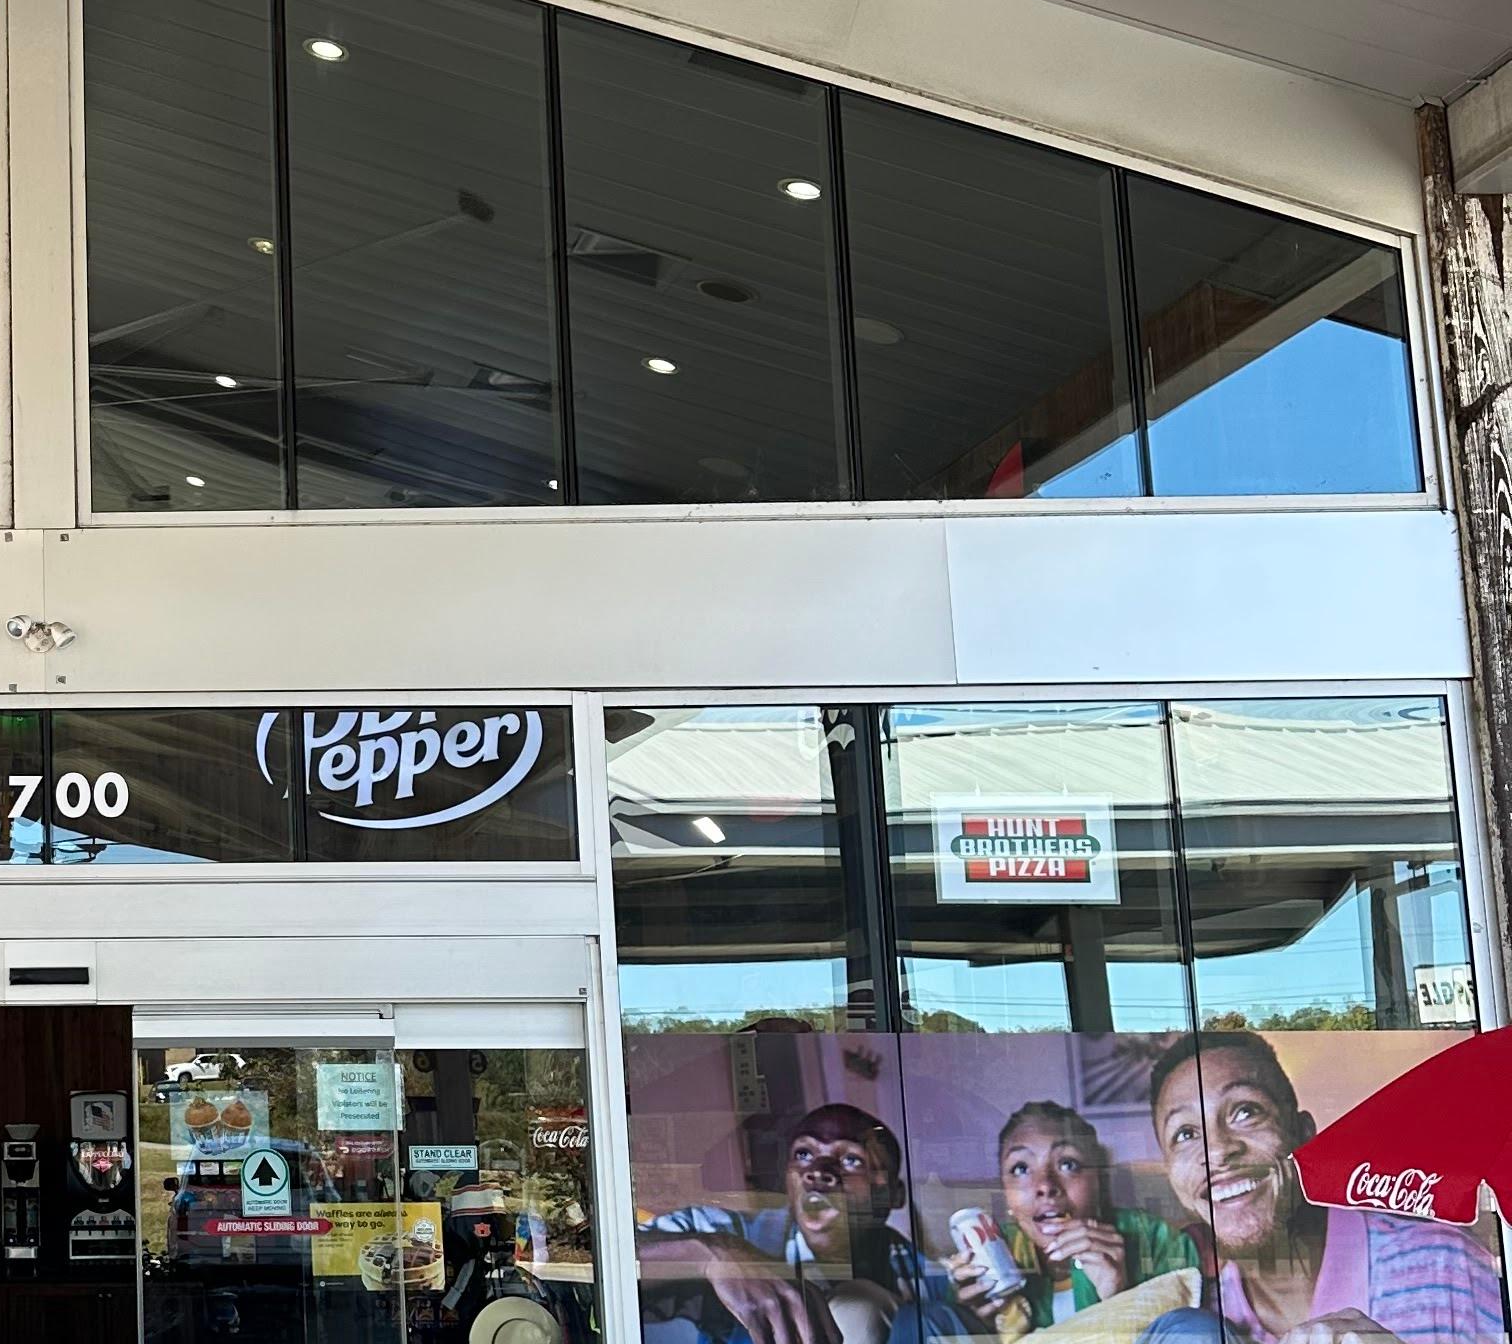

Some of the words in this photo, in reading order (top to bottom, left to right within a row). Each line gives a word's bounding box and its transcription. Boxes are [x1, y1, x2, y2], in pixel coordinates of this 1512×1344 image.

[987, 817, 1061, 837] HUNT
[959, 838, 1092, 857] BROTHERS
[988, 857, 1067, 877] PIZZA
[341, 1071, 376, 1082] NOTICE
[413, 1149, 442, 1159] STAND
[443, 1149, 472, 1159] CLEAR
[1345, 1162, 1444, 1218] Coca-Cola
[316, 1208, 352, 1218] Waffles
[216, 1221, 263, 1232] AUTOMATIC
[263, 1221, 295, 1232] SLIDING
[296, 1221, 319, 1231] DOOR
[334, 1220, 355, 1229] way
[357, 1219, 368, 1228] to
